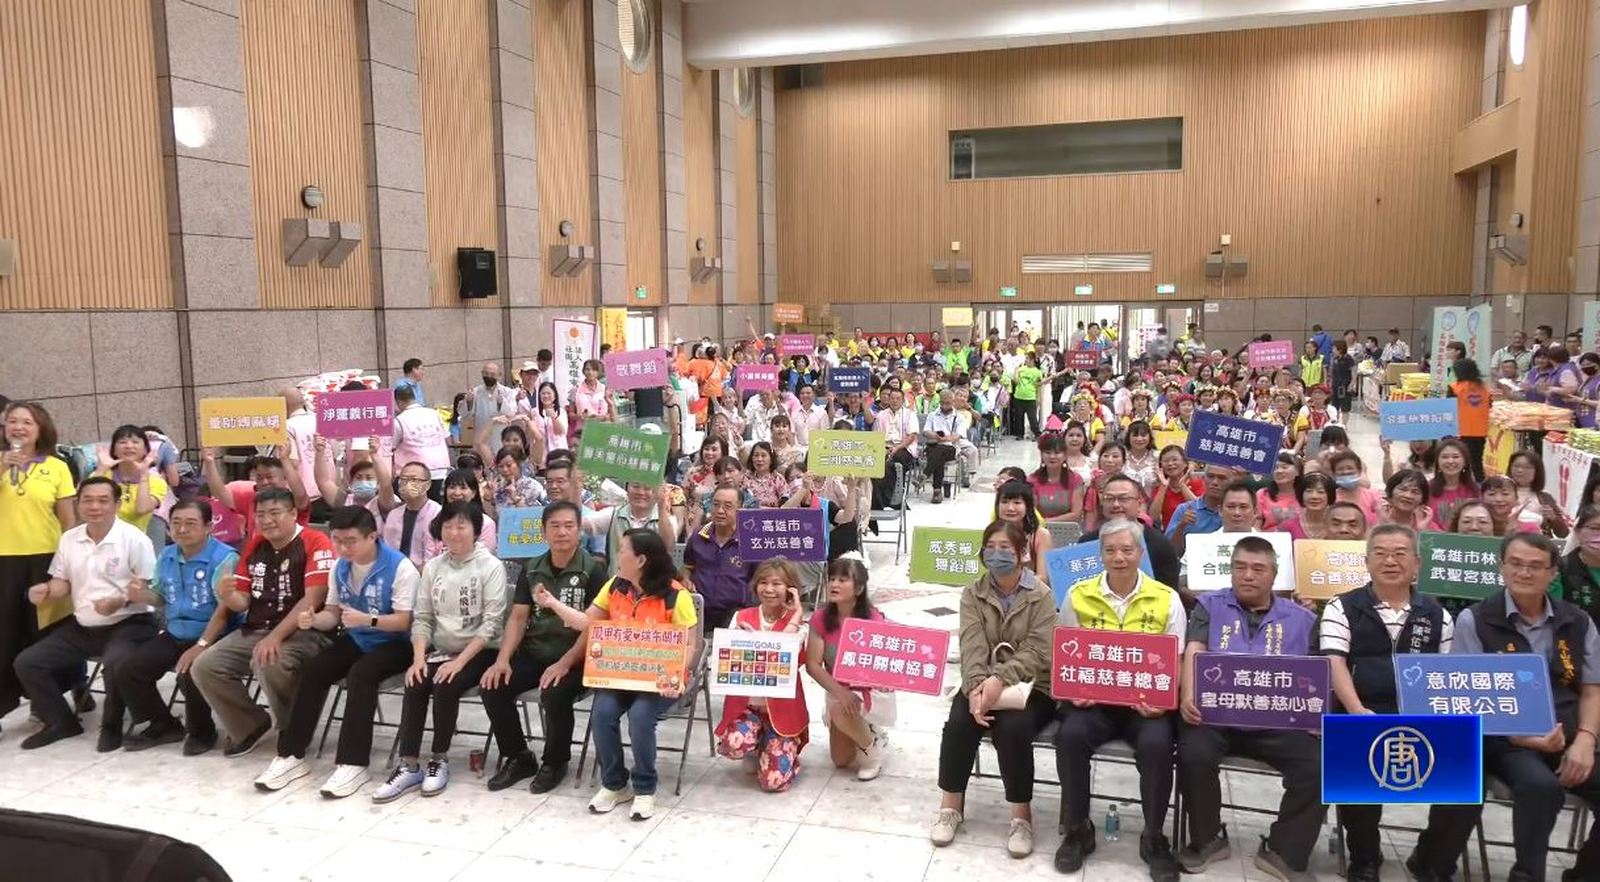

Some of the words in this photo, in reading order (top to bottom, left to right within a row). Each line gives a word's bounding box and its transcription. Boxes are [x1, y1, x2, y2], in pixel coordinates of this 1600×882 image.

[1216, 423, 1257, 443] 高雄市
[1198, 438, 1267, 463] 慈海慈善會
[762, 519, 800, 532] 高雄市
[751, 536, 814, 549] 玄光慈善會
[1431, 547, 1499, 566] 高雄市林
[754, 641, 783, 650] GOALS
[869, 633, 918, 653] 高雄市
[1088, 643, 1144, 664] 高雄市
[841, 651, 938, 679] 鳳甲關懷協會
[1060, 665, 1172, 692] 社福慈善總會
[1233, 669, 1293, 689] 高雄市
[1426, 671, 1517, 692] 意欣國際
[1428, 696, 1519, 715] 有限公司
